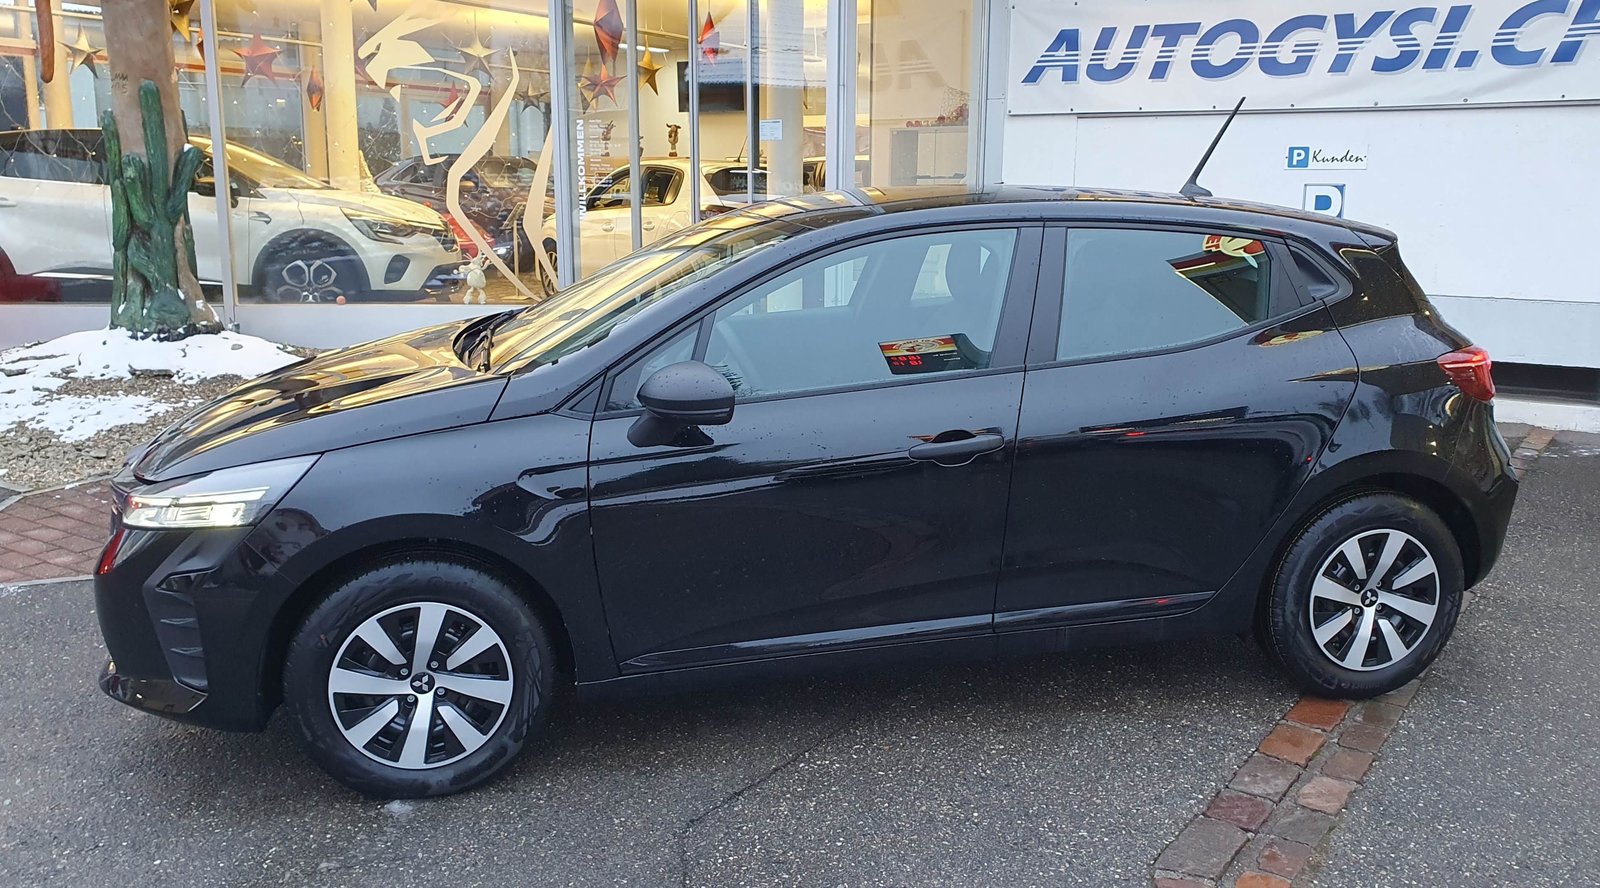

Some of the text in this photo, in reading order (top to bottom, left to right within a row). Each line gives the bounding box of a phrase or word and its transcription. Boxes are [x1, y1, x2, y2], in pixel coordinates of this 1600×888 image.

[576, 119, 587, 220] WILLKOMMEN
[1292, 149, 1364, 165] P Kunden
